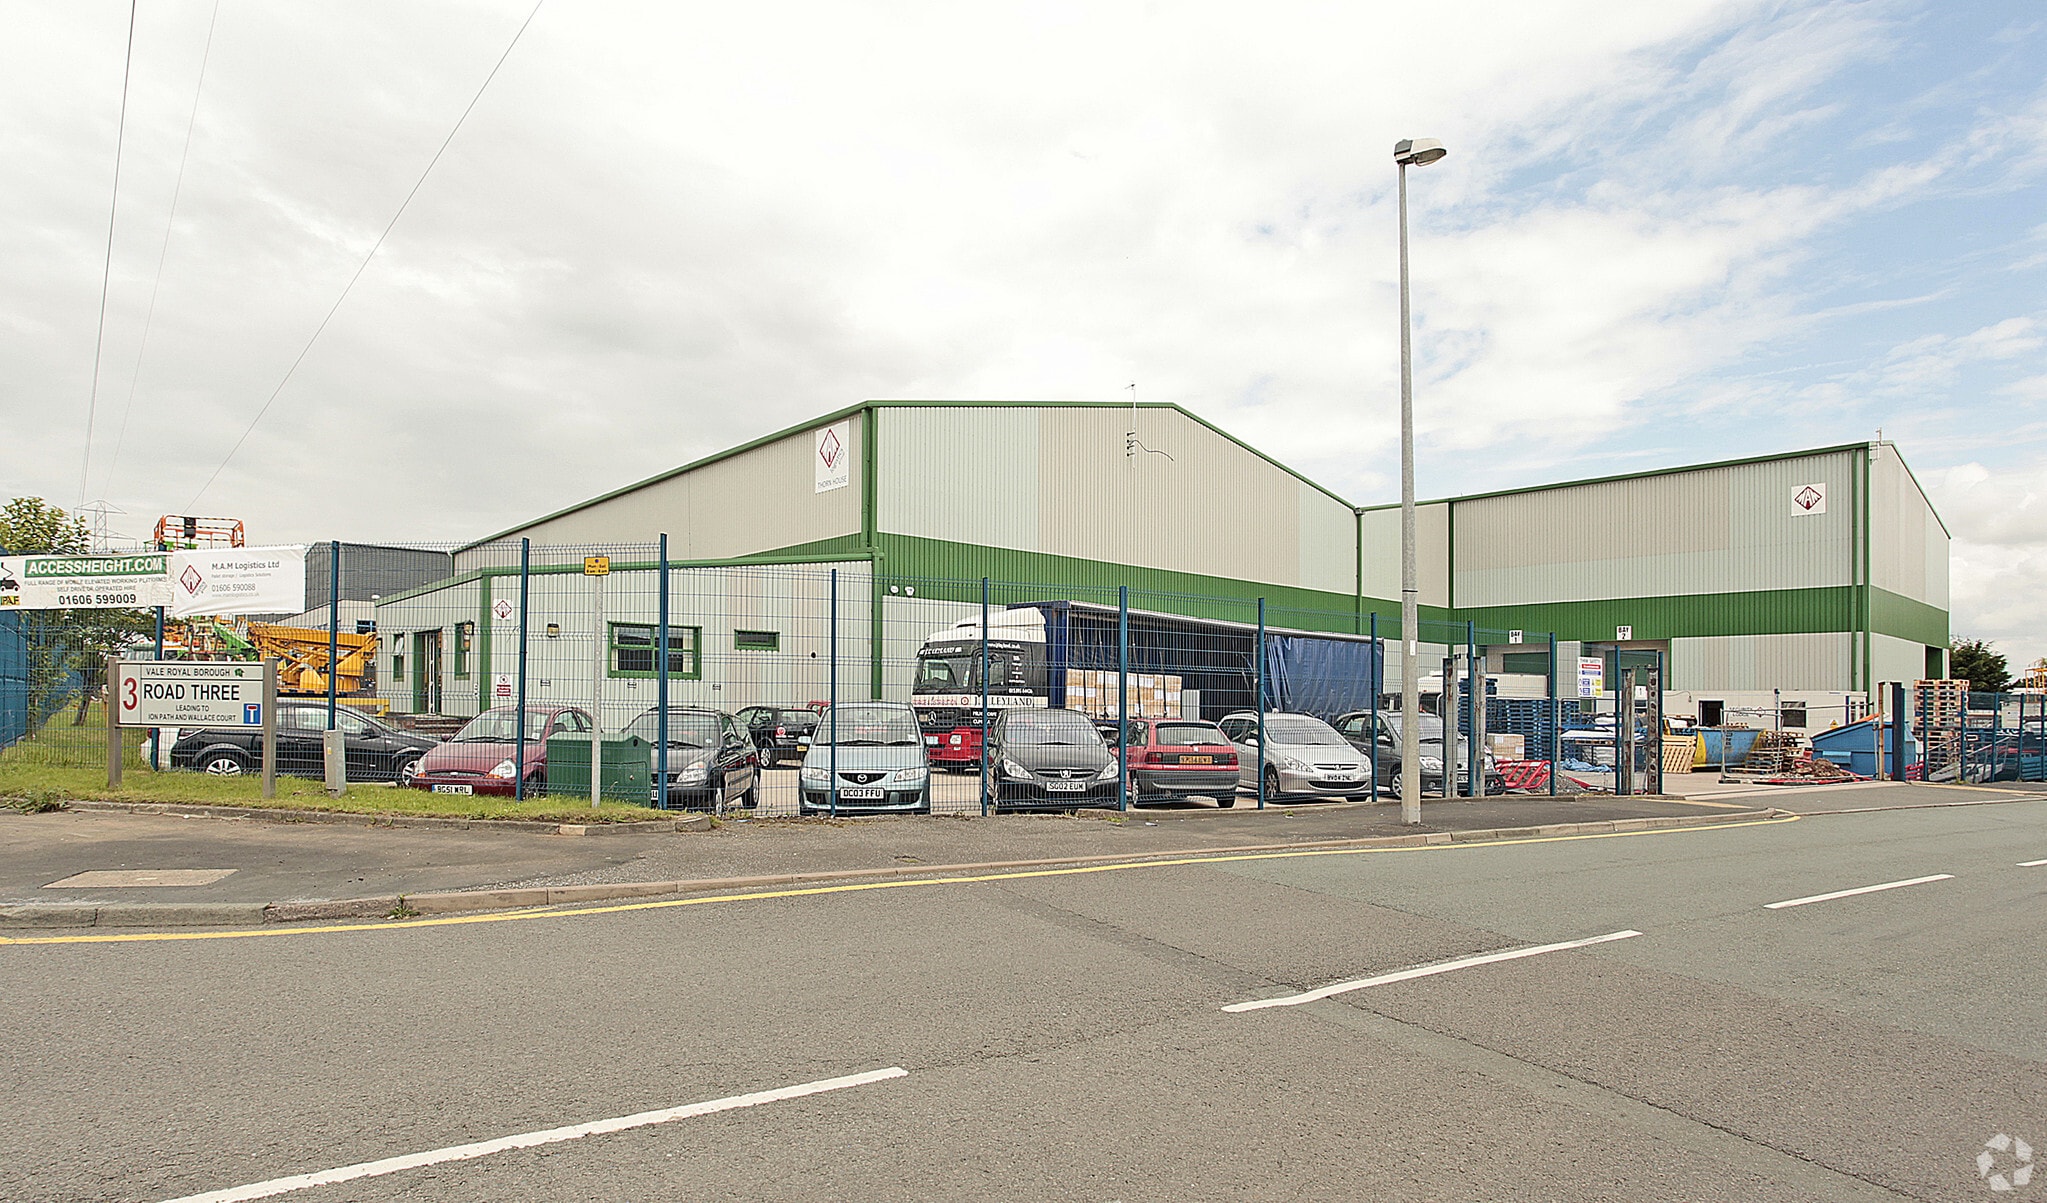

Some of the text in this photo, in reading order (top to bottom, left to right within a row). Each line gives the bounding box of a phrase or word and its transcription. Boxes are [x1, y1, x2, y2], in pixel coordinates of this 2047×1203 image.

[28, 558, 163, 574] ACCESSHEIGHT.COM
[235, 562, 266, 571] Logistics
[211, 584, 231, 592] 01606
[232, 583, 256, 592] 590088
[58, 594, 137, 605] 01606 599009
[146, 667, 231, 677] VALE ROYAL BOROUGH
[123, 677, 138, 711] 3
[143, 683, 240, 701] ROAD THREE
[991, 696, 1033, 706] LEYLAND
[437, 785, 453, 793] BG51
[843, 789, 881, 797] DC03 FFU
